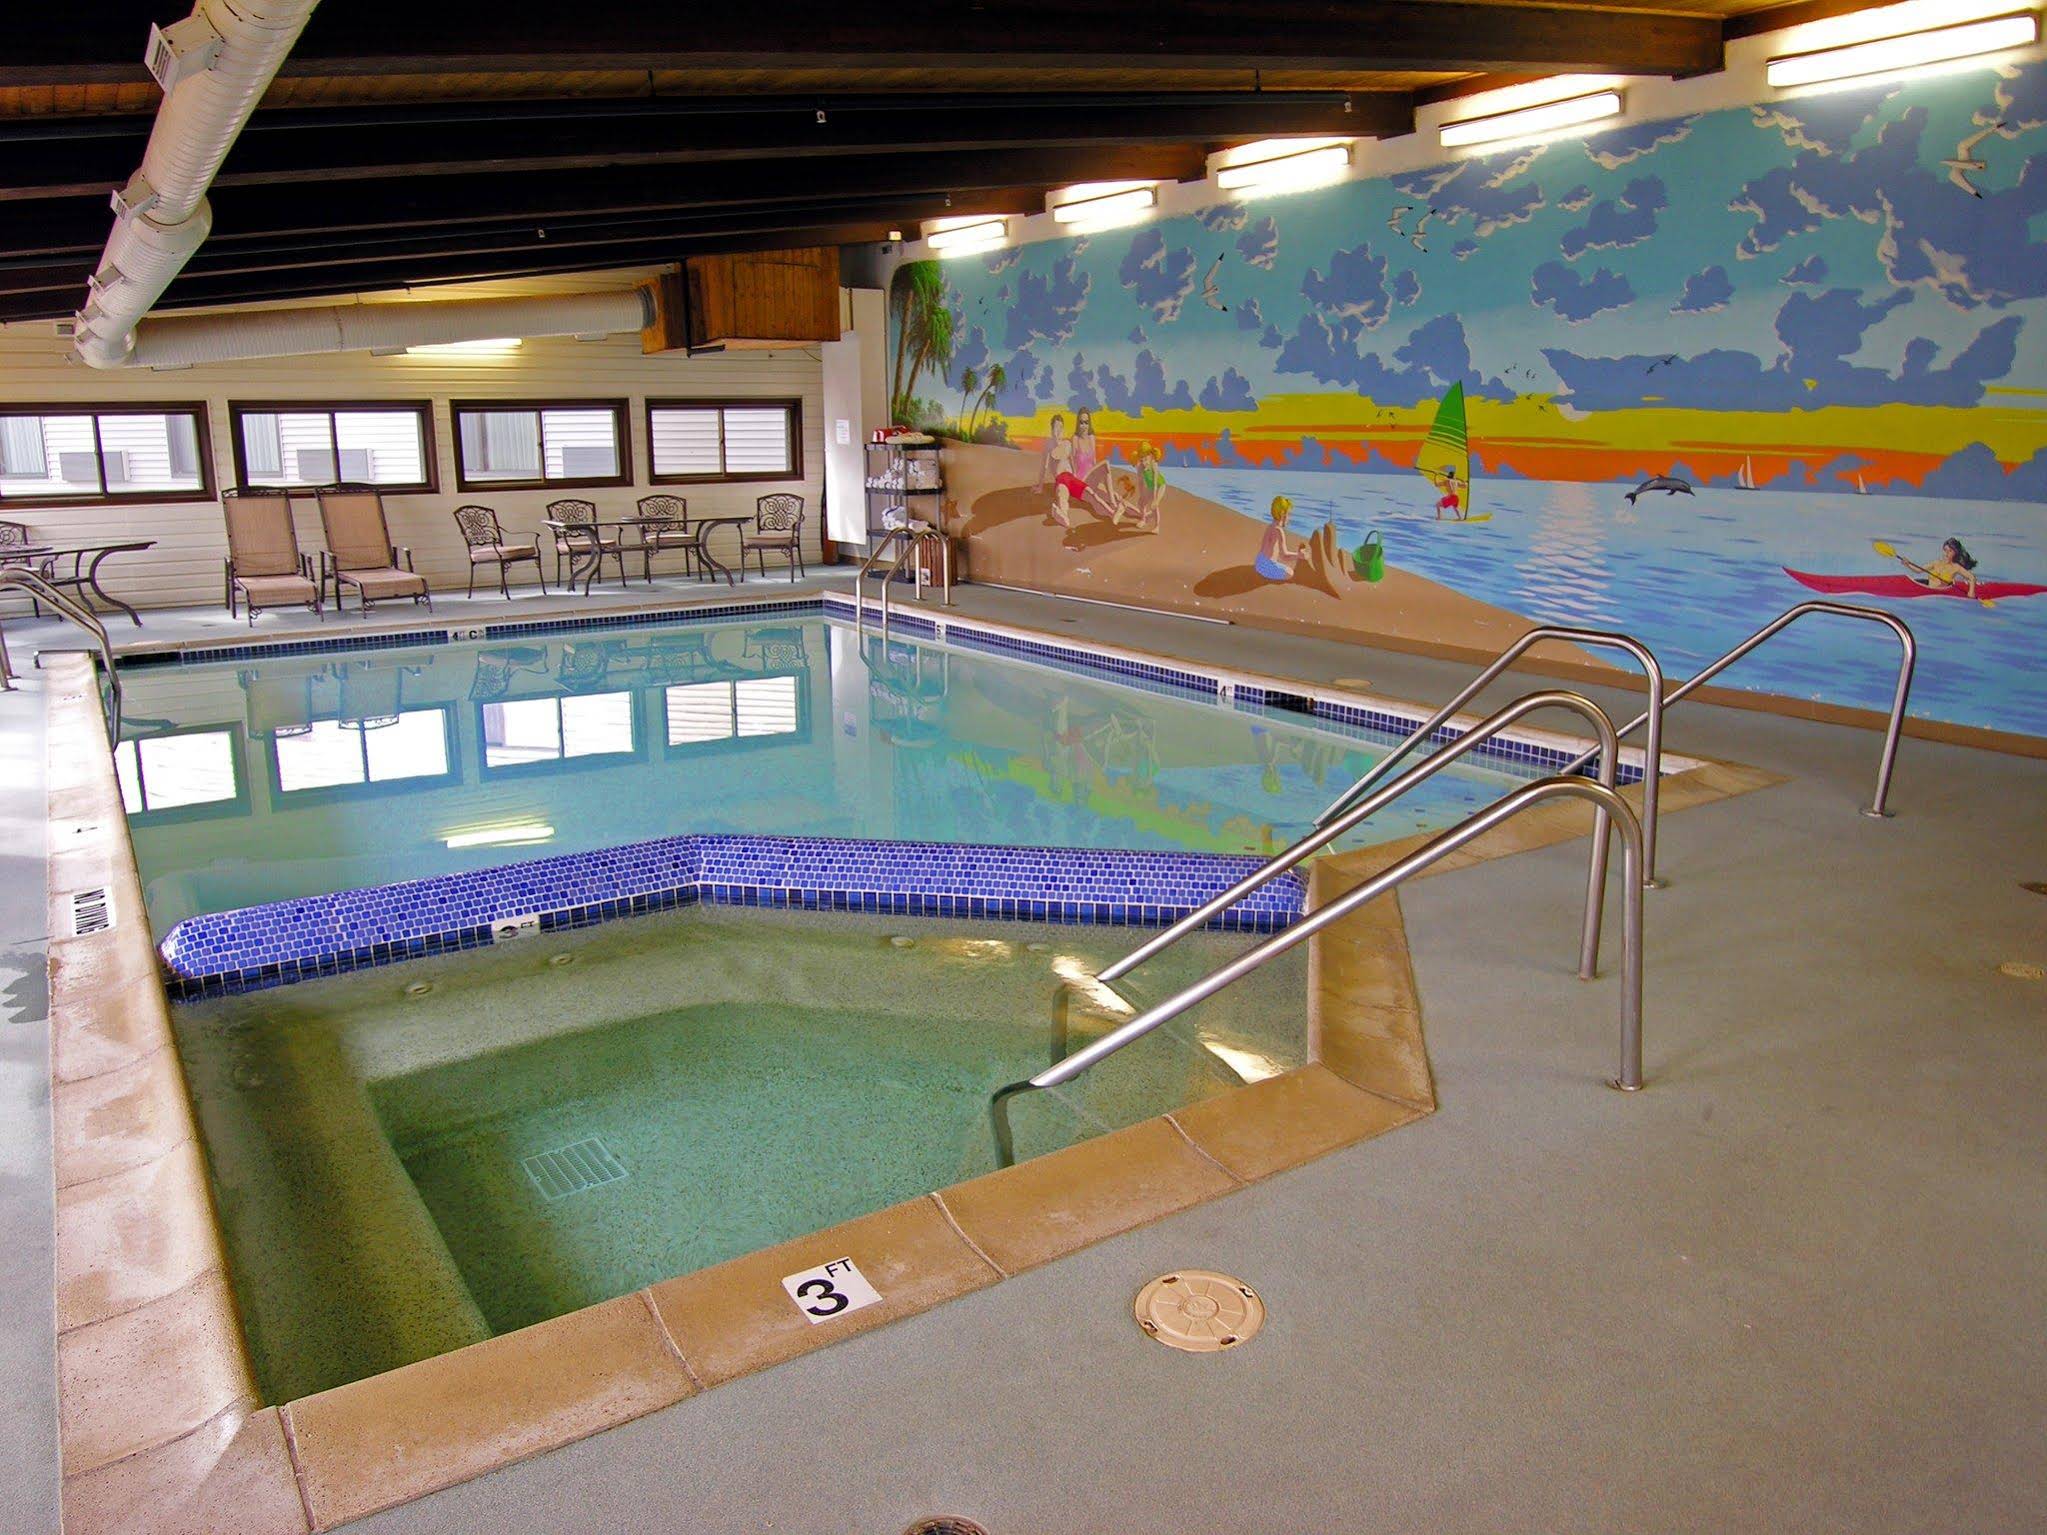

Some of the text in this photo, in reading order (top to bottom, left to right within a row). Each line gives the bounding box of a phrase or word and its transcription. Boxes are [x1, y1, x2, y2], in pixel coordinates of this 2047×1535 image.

[74, 888, 109, 934] NO DIVING
[797, 1258, 851, 1316] 3 FT
